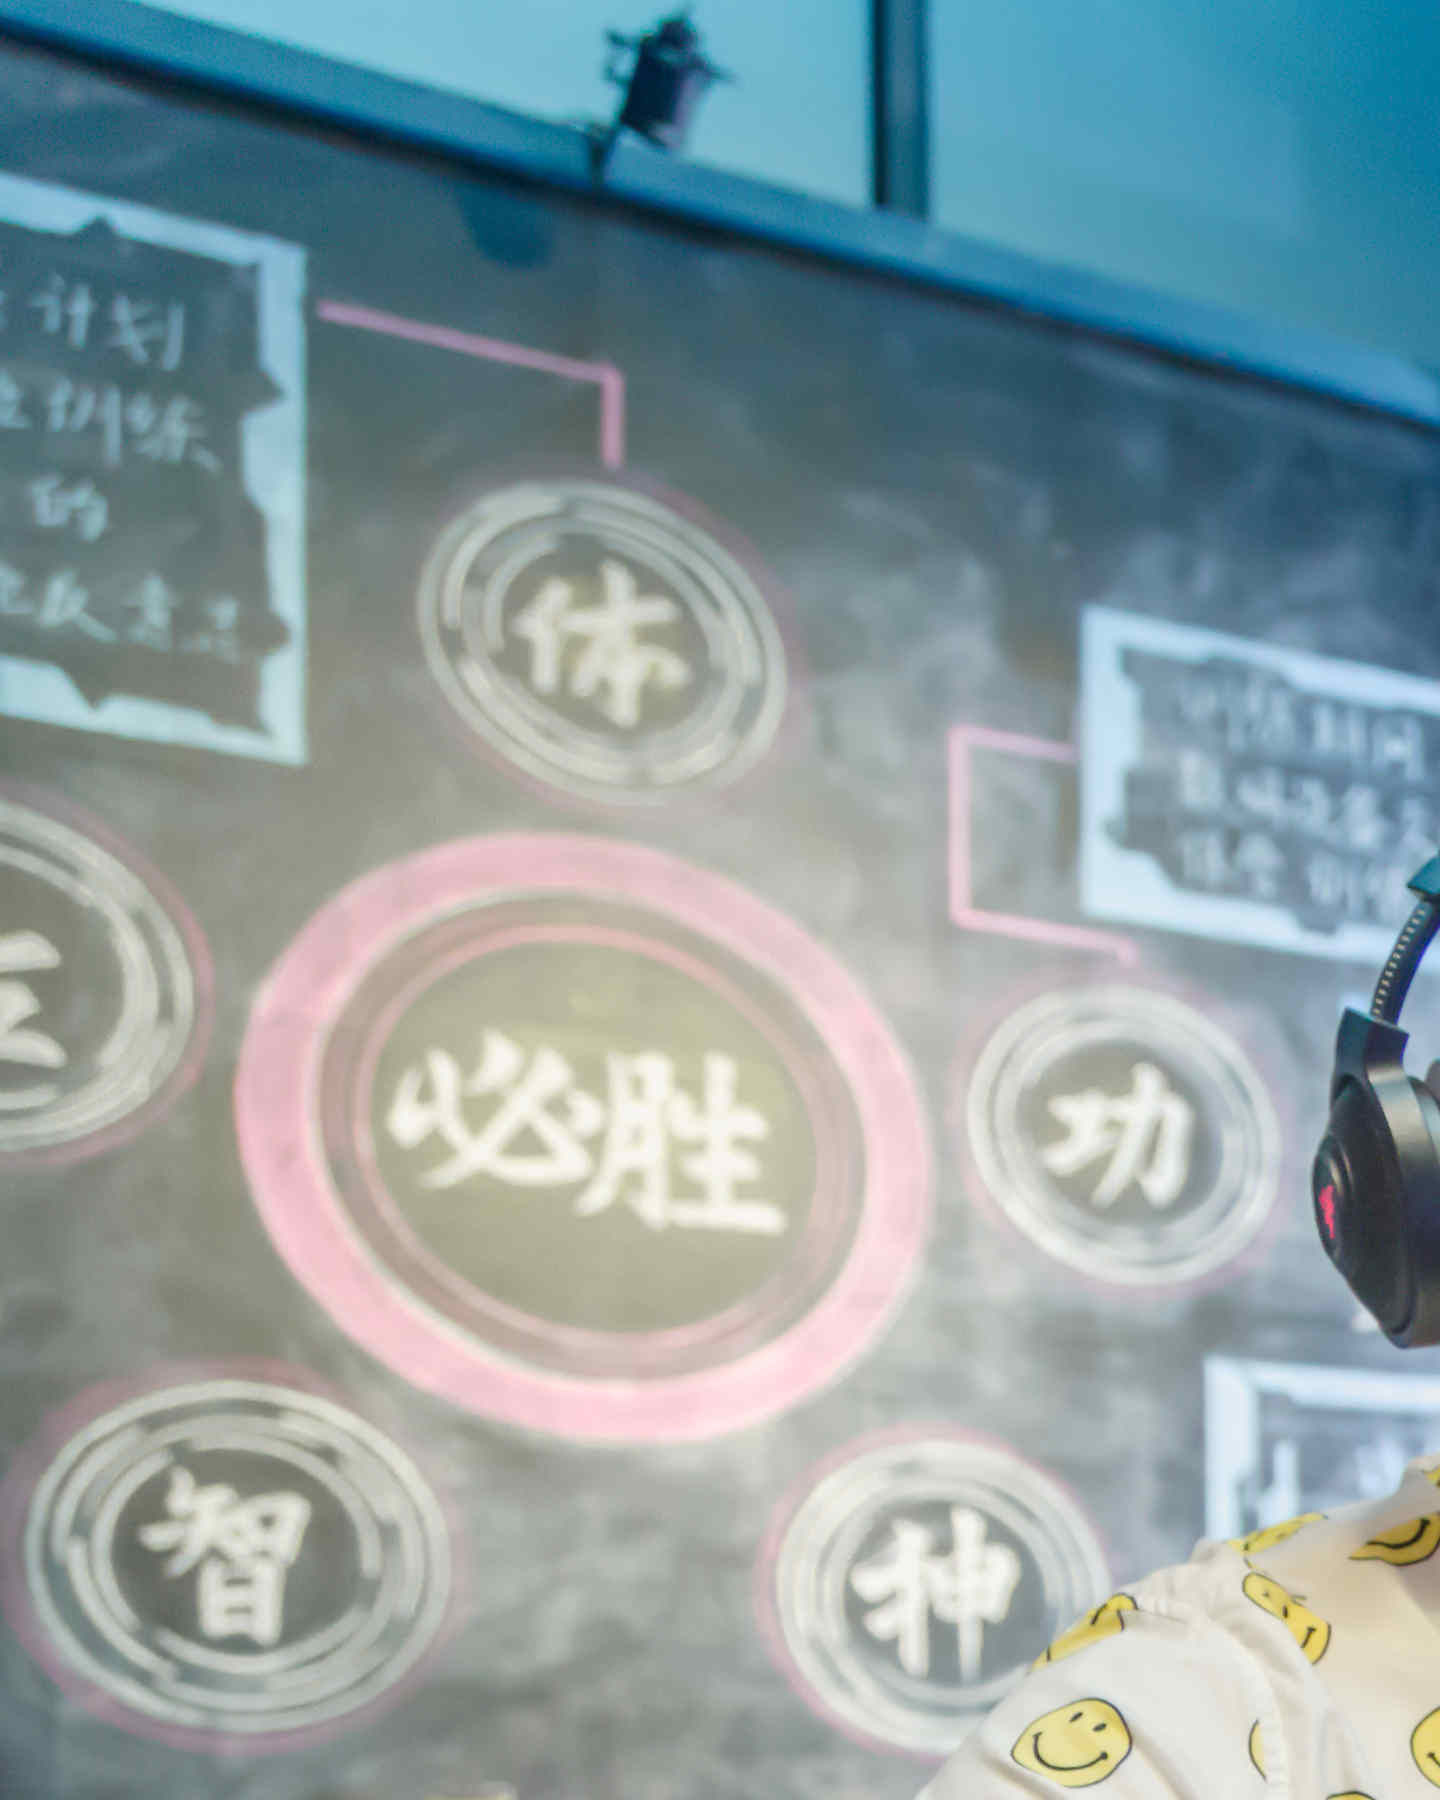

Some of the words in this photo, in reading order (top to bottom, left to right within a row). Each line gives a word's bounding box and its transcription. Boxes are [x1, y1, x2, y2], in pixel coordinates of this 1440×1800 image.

[0, 270, 187, 372] 计划
[512, 560, 692, 728] 体
[387, 1029, 786, 1236] 必胜
[1041, 1061, 1194, 1211] 功
[138, 1465, 312, 1648] 智
[850, 1506, 1023, 1683] 神
